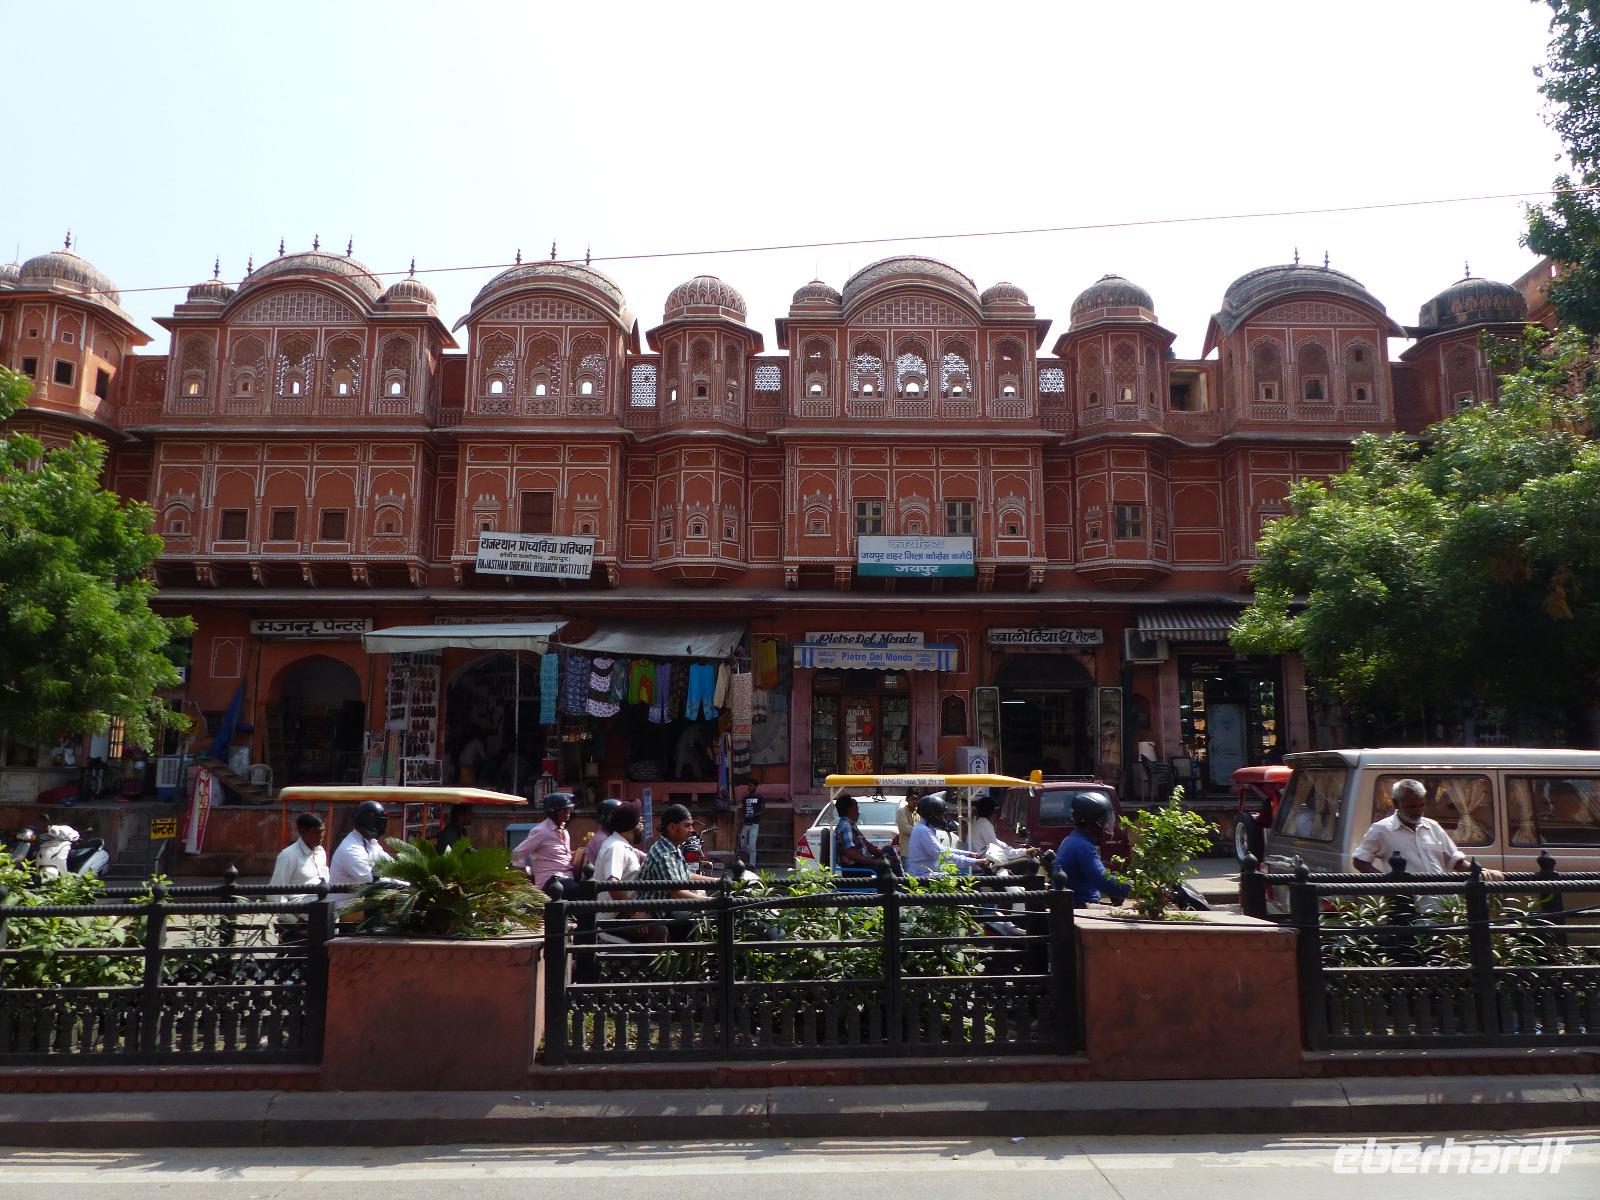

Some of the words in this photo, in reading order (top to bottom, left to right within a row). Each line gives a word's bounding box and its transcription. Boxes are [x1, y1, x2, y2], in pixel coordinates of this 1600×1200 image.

[480, 538, 517, 550] राजस्थान
[518, 540, 558, 554] प्राच्यविद्या
[559, 542, 593, 555] प्रतिष्ठान
[861, 552, 885, 562] जयपुर
[904, 550, 924, 560] जिला
[478, 558, 508, 570] RAJASTHAN
[509, 560, 532, 572] ORIENTAL
[534, 562, 558, 573] RESEARCH
[894, 565, 940, 576] जयपुर
[816, 632, 856, 645] Pietre
[856, 632, 876, 644] Del
[876, 632, 918, 644] Mondo
[841, 652, 867, 662] Pietre
[869, 652, 883, 662] Del
[886, 652, 913, 662] Mondo
